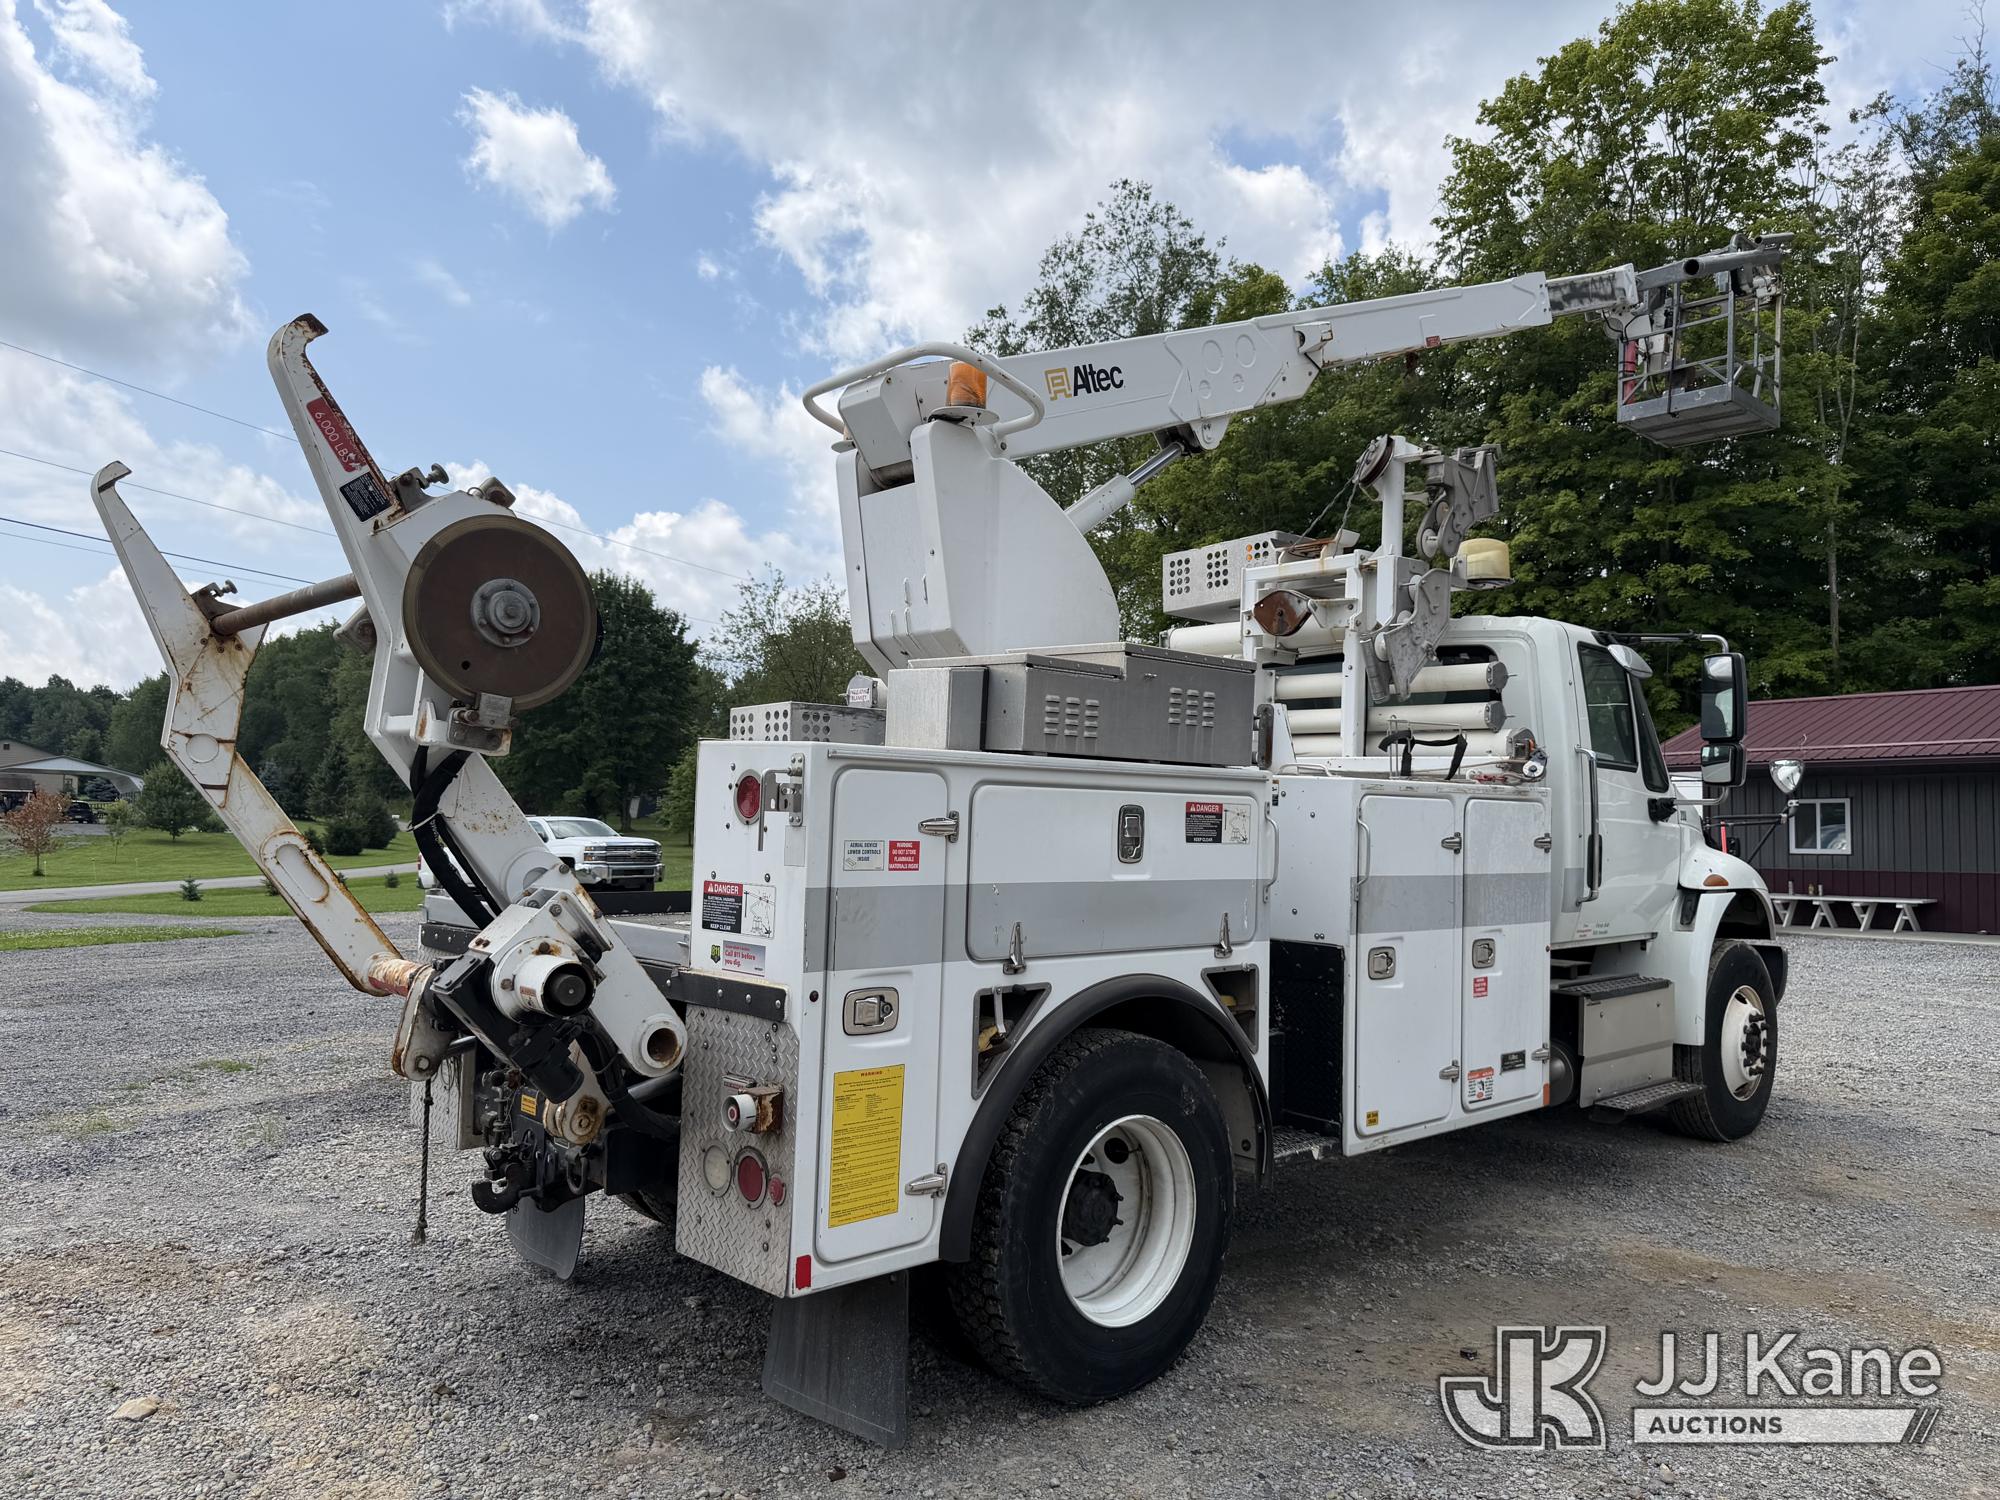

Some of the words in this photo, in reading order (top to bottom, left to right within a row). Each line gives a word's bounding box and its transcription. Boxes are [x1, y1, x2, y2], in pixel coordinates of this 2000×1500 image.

[1073, 364, 1124, 396] Altec
[314, 412, 339, 441] 6,000
[1196, 804, 1219, 812] DANGER
[714, 885, 739, 895] DANGER
[741, 952, 756, 960] before
[724, 958, 733, 966] you
